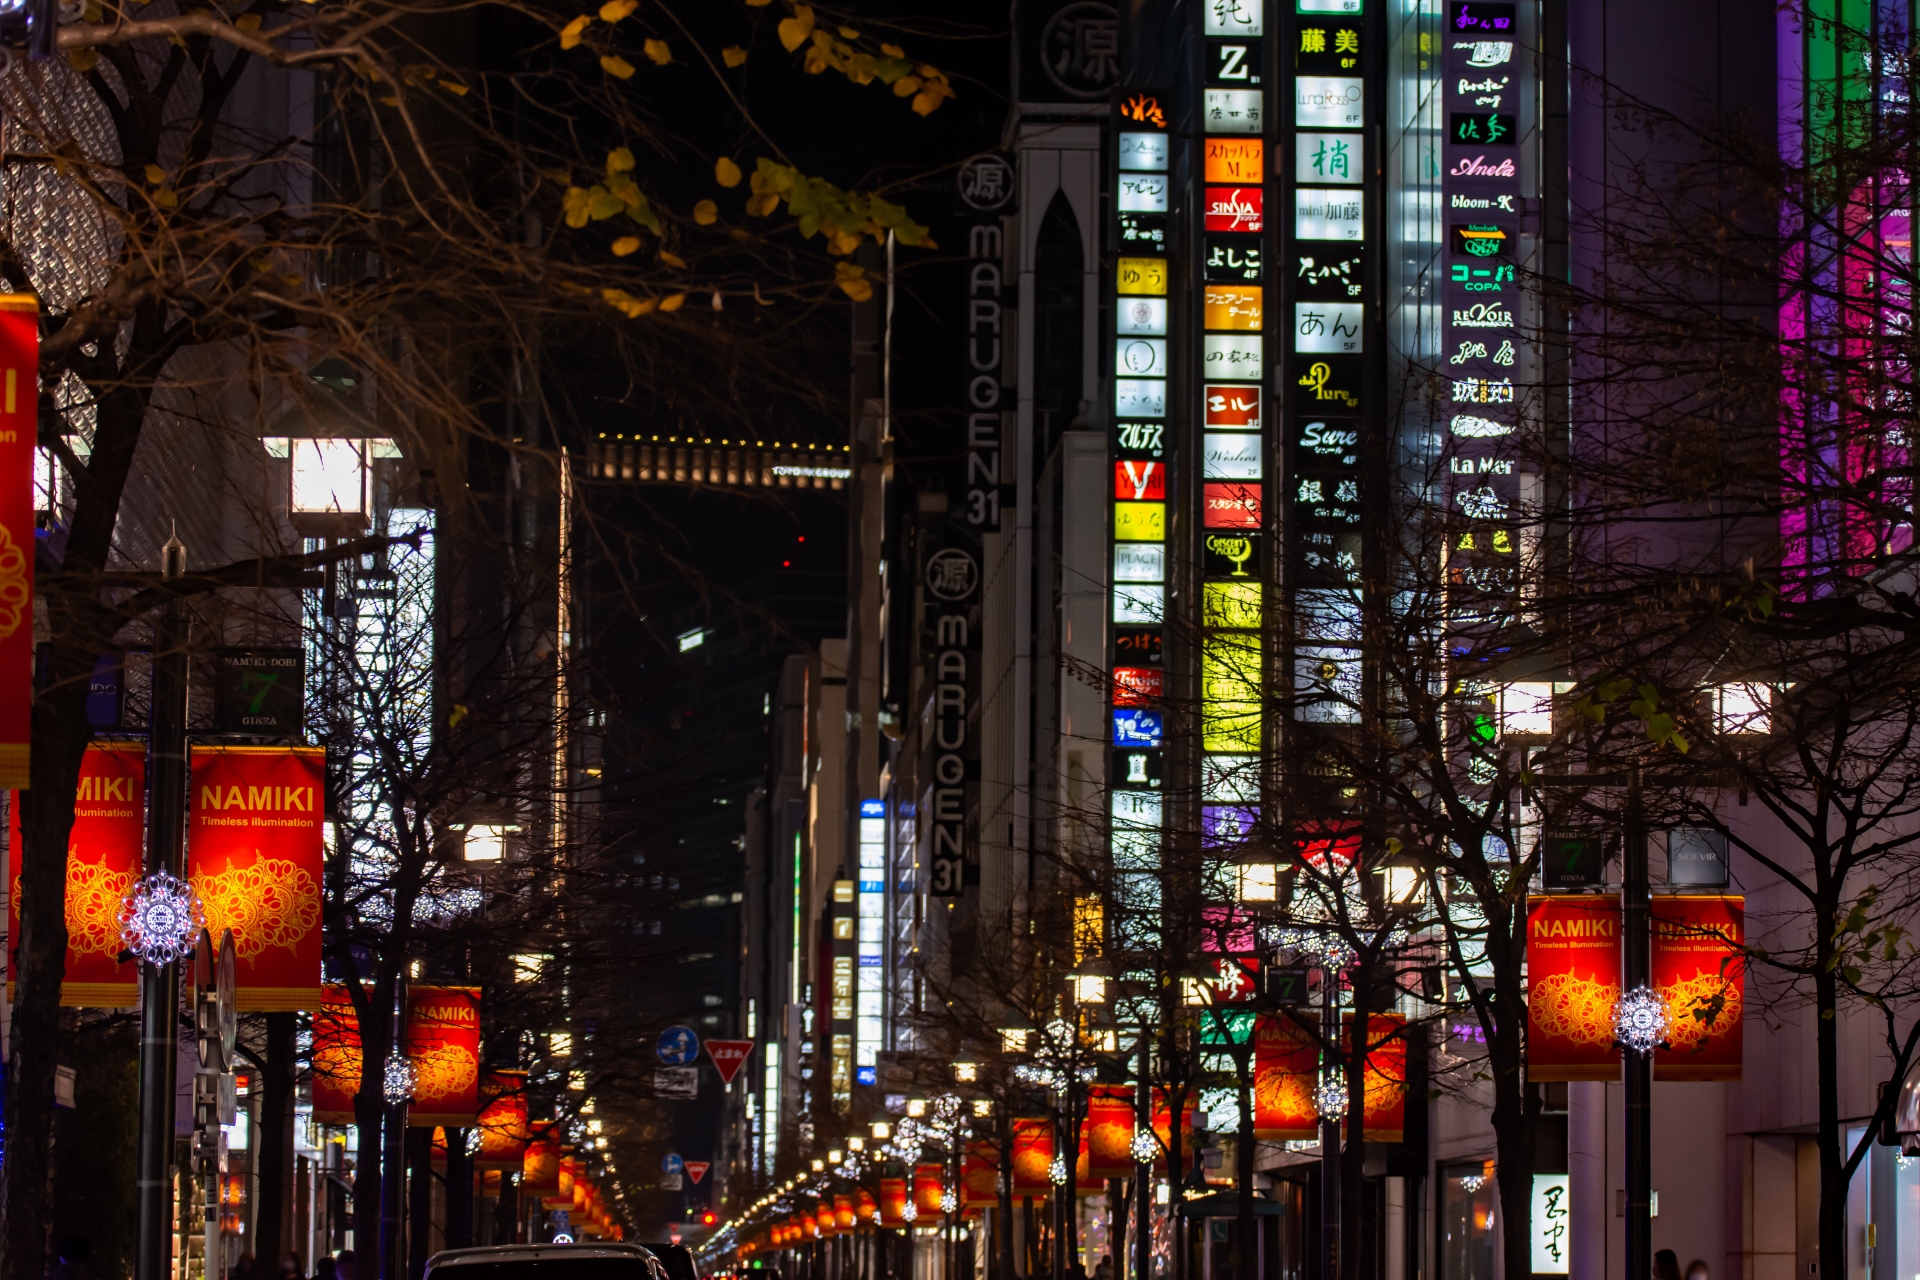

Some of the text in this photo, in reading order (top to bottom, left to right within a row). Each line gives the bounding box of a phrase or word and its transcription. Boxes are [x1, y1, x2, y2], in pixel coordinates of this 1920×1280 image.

[1301, 28, 1359, 53] 藤美
[1219, 45, 1248, 79] Z
[1340, 58, 1356, 68] 6F
[1346, 115, 1359, 123] 6F
[1311, 140, 1349, 178] 梢
[1226, 162, 1240, 177] M
[1450, 155, 1515, 177] Anela
[966, 164, 1005, 199] 源
[1451, 194, 1514, 212] bloom-K
[1248, 222, 1261, 230] 5F
[1348, 230, 1359, 238] 5F
[1207, 247, 1260, 268] よしこ
[1123, 270, 1161, 287] ゆう
[1243, 270, 1258, 279] 4F
[1348, 285, 1362, 296] 5F
[1464, 282, 1502, 291] COPA
[1206, 294, 1254, 305] フェアリー
[1228, 307, 1260, 317] テール
[1249, 320, 1260, 328] 4F
[1300, 311, 1358, 338] あん
[1343, 342, 1356, 350] 5F
[1298, 376, 1316, 386] club
[1206, 447, 1257, 463] Wishes
[1343, 455, 1356, 464] 4F
[815, 468, 851, 479] GROUP
[1117, 512, 1161, 527] ゆうな
[1120, 553, 1157, 564] PLACE
[933, 558, 970, 592] 源
[243, 672, 278, 714] 7
[242, 717, 277, 725] GINZA
[76, 777, 133, 801] MIKI
[201, 785, 313, 811] NAMIKI
[75, 808, 134, 818] llumination
[201, 816, 248, 827] Timeless
[1562, 843, 1584, 872] 7
[1677, 852, 1717, 861] NOEVIR
[1534, 919, 1614, 938] NAMIKI
[1658, 922, 1737, 941] NAMIKI
[1534, 941, 1568, 949] Timeless
[1278, 977, 1296, 997] 7
[414, 1006, 475, 1021] NAMIKI
[714, 1048, 744, 1059] 止まれ
